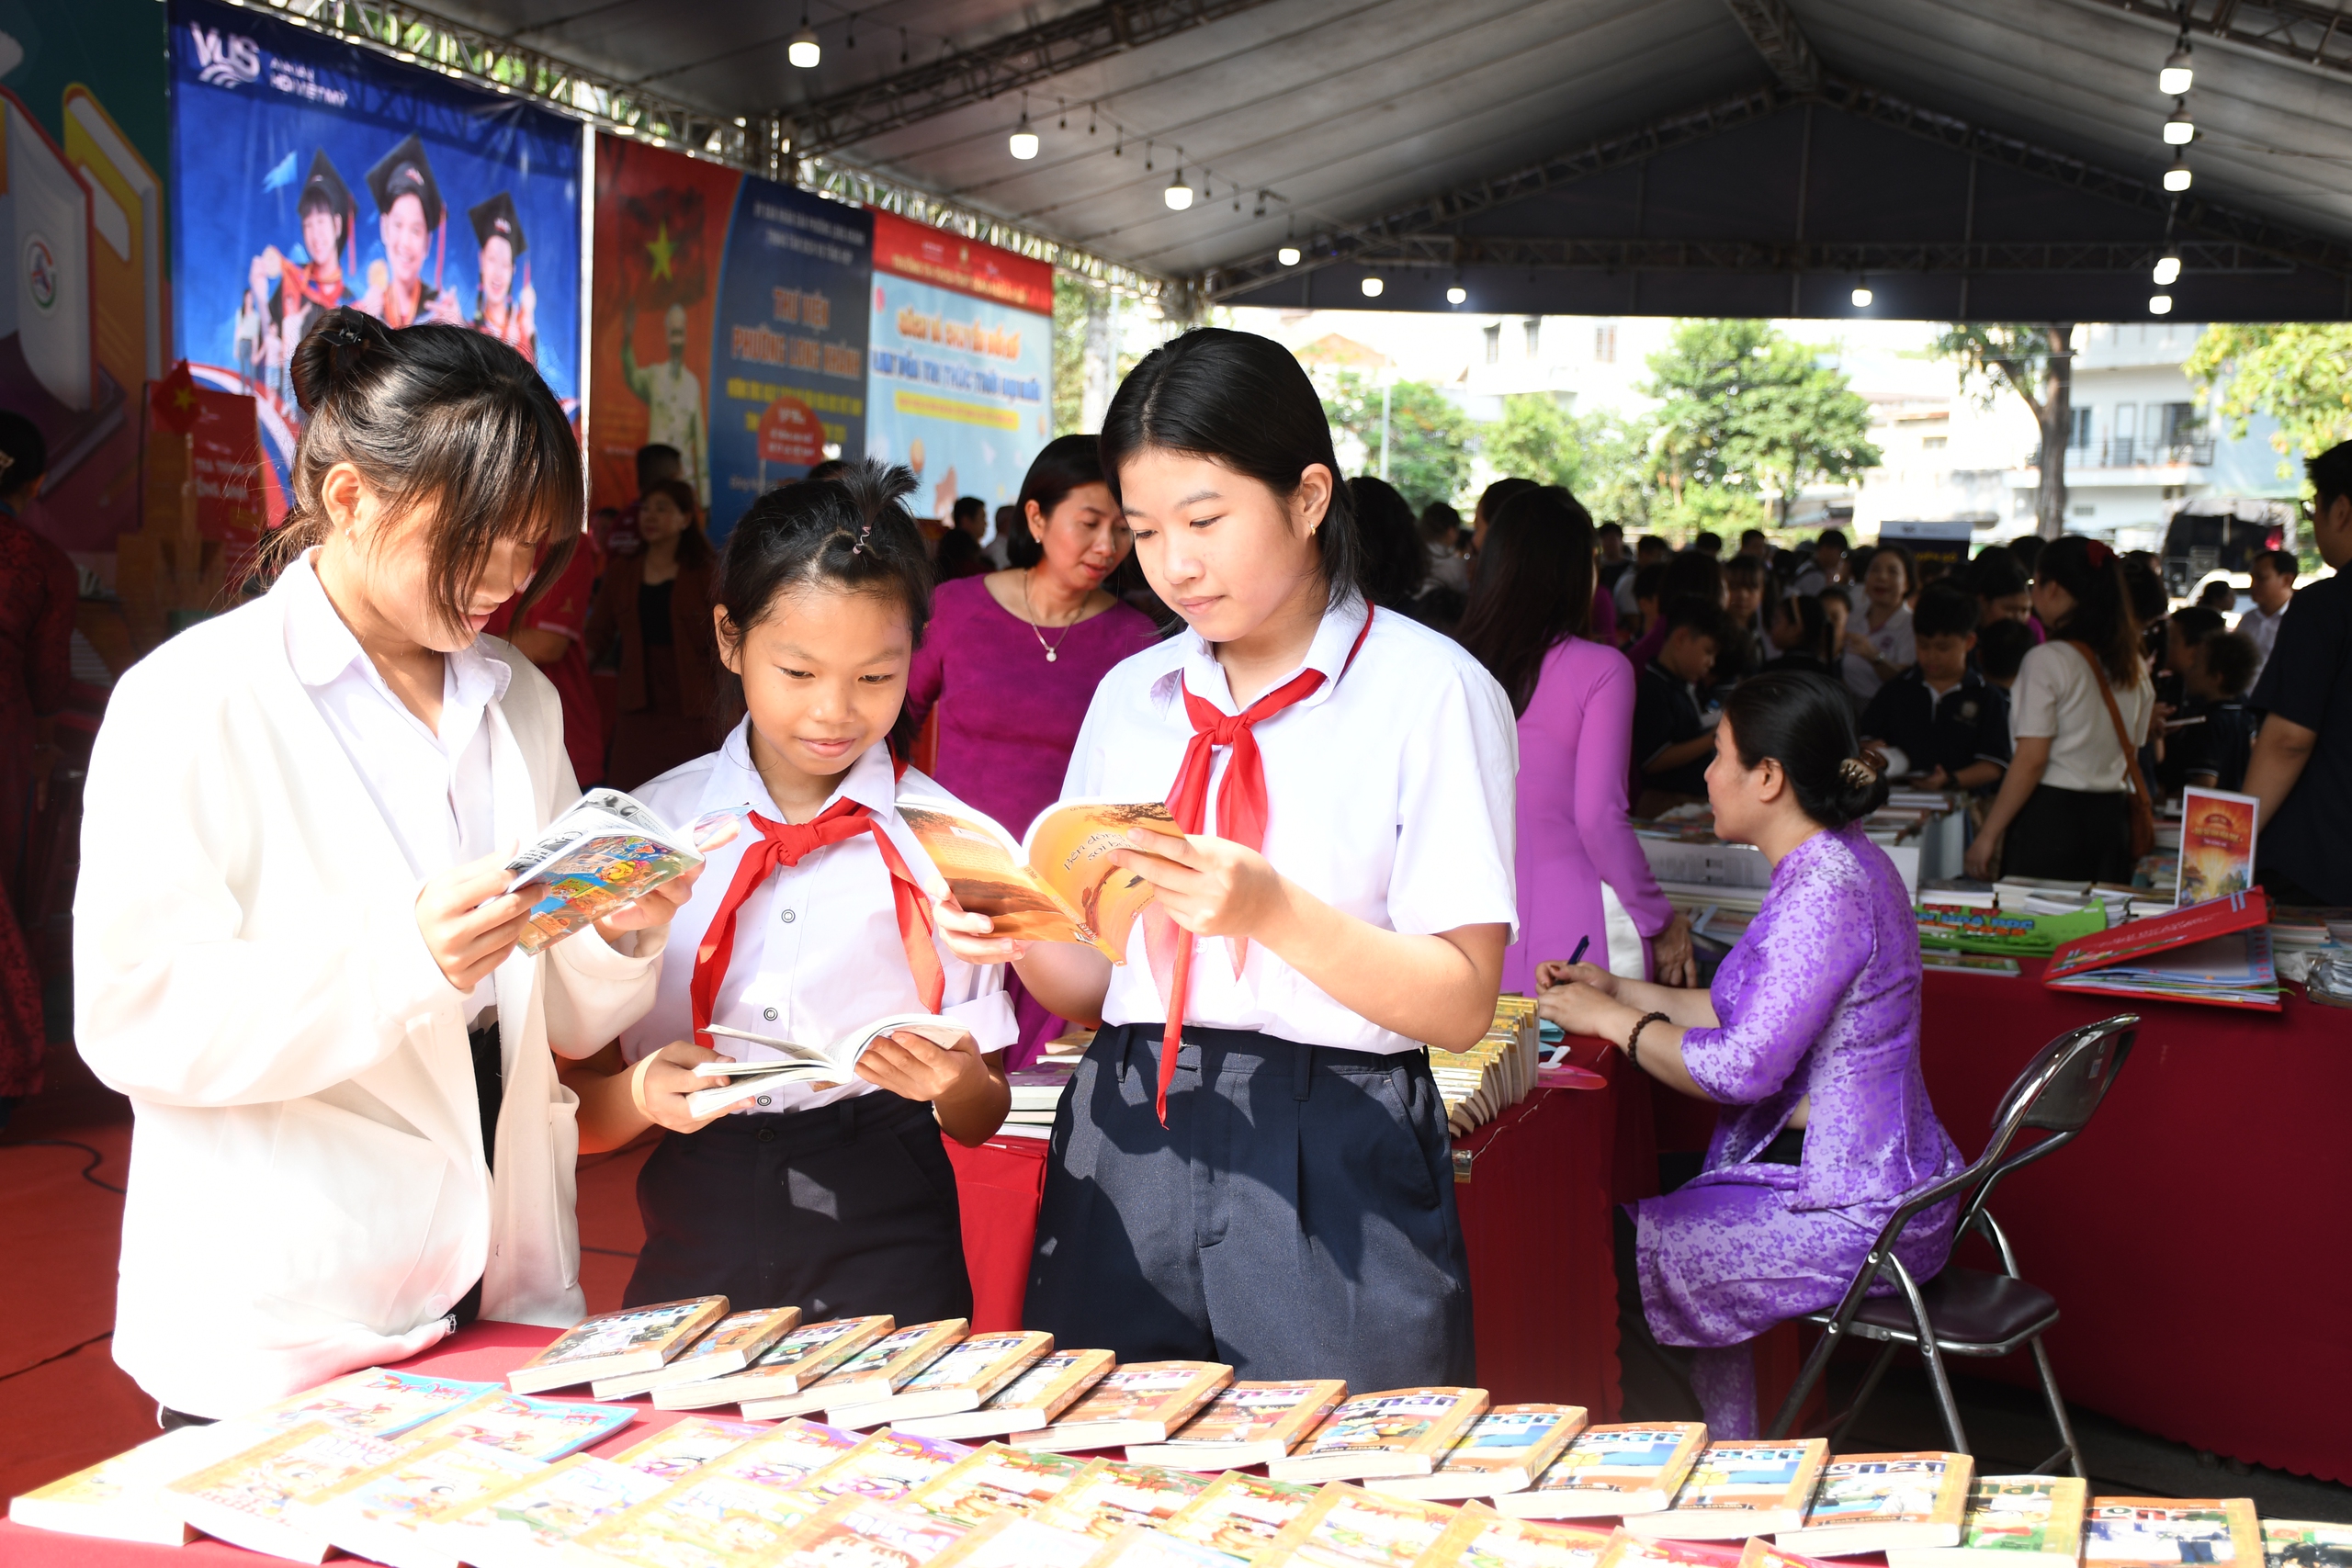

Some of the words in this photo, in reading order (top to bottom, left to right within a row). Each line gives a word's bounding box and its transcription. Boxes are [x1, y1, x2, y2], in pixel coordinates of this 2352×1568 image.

[190, 21, 260, 83] VUS
[1063, 844, 1086, 872] Bên
[1087, 831, 1124, 845] dòng
[1087, 843, 1107, 862] soi
